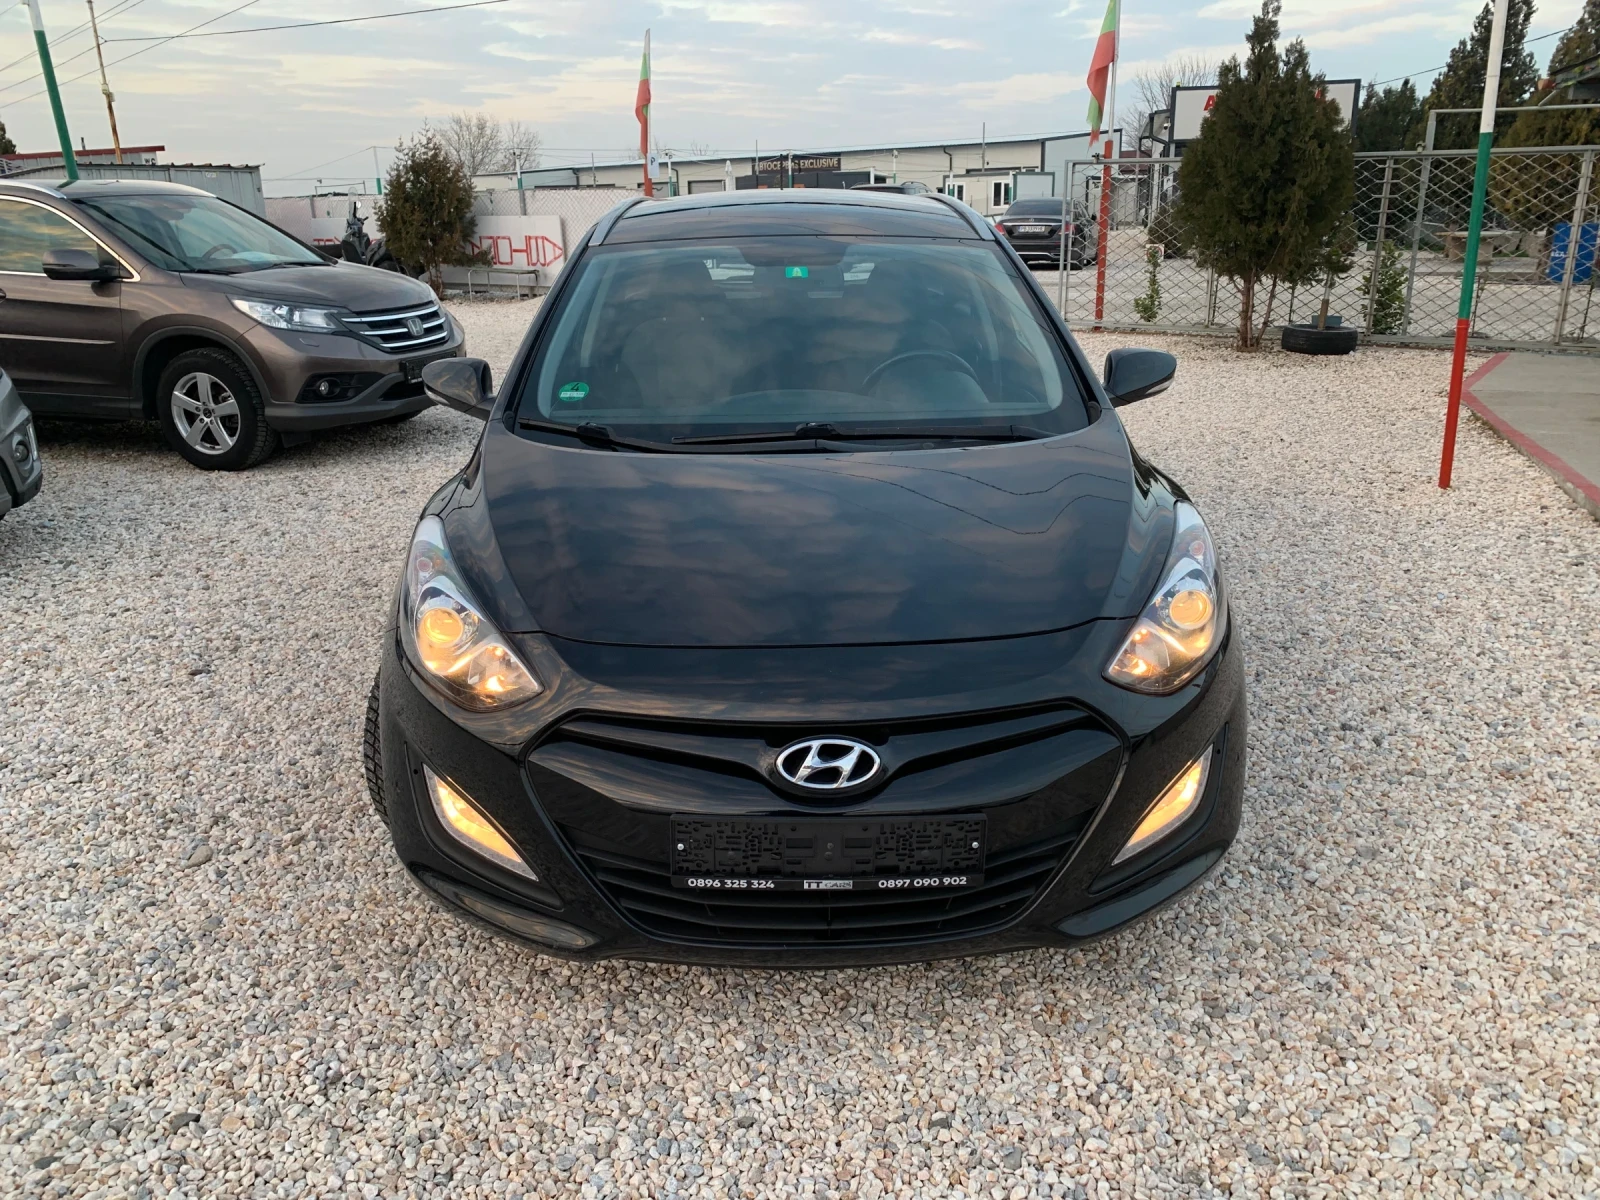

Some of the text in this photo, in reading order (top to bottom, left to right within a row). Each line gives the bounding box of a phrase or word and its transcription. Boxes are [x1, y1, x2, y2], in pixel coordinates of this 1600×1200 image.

[800, 158, 839, 169] EXCLUSIVE
[687, 878, 775, 889] 0896 325 324
[878, 876, 967, 888] 0897 090 902
